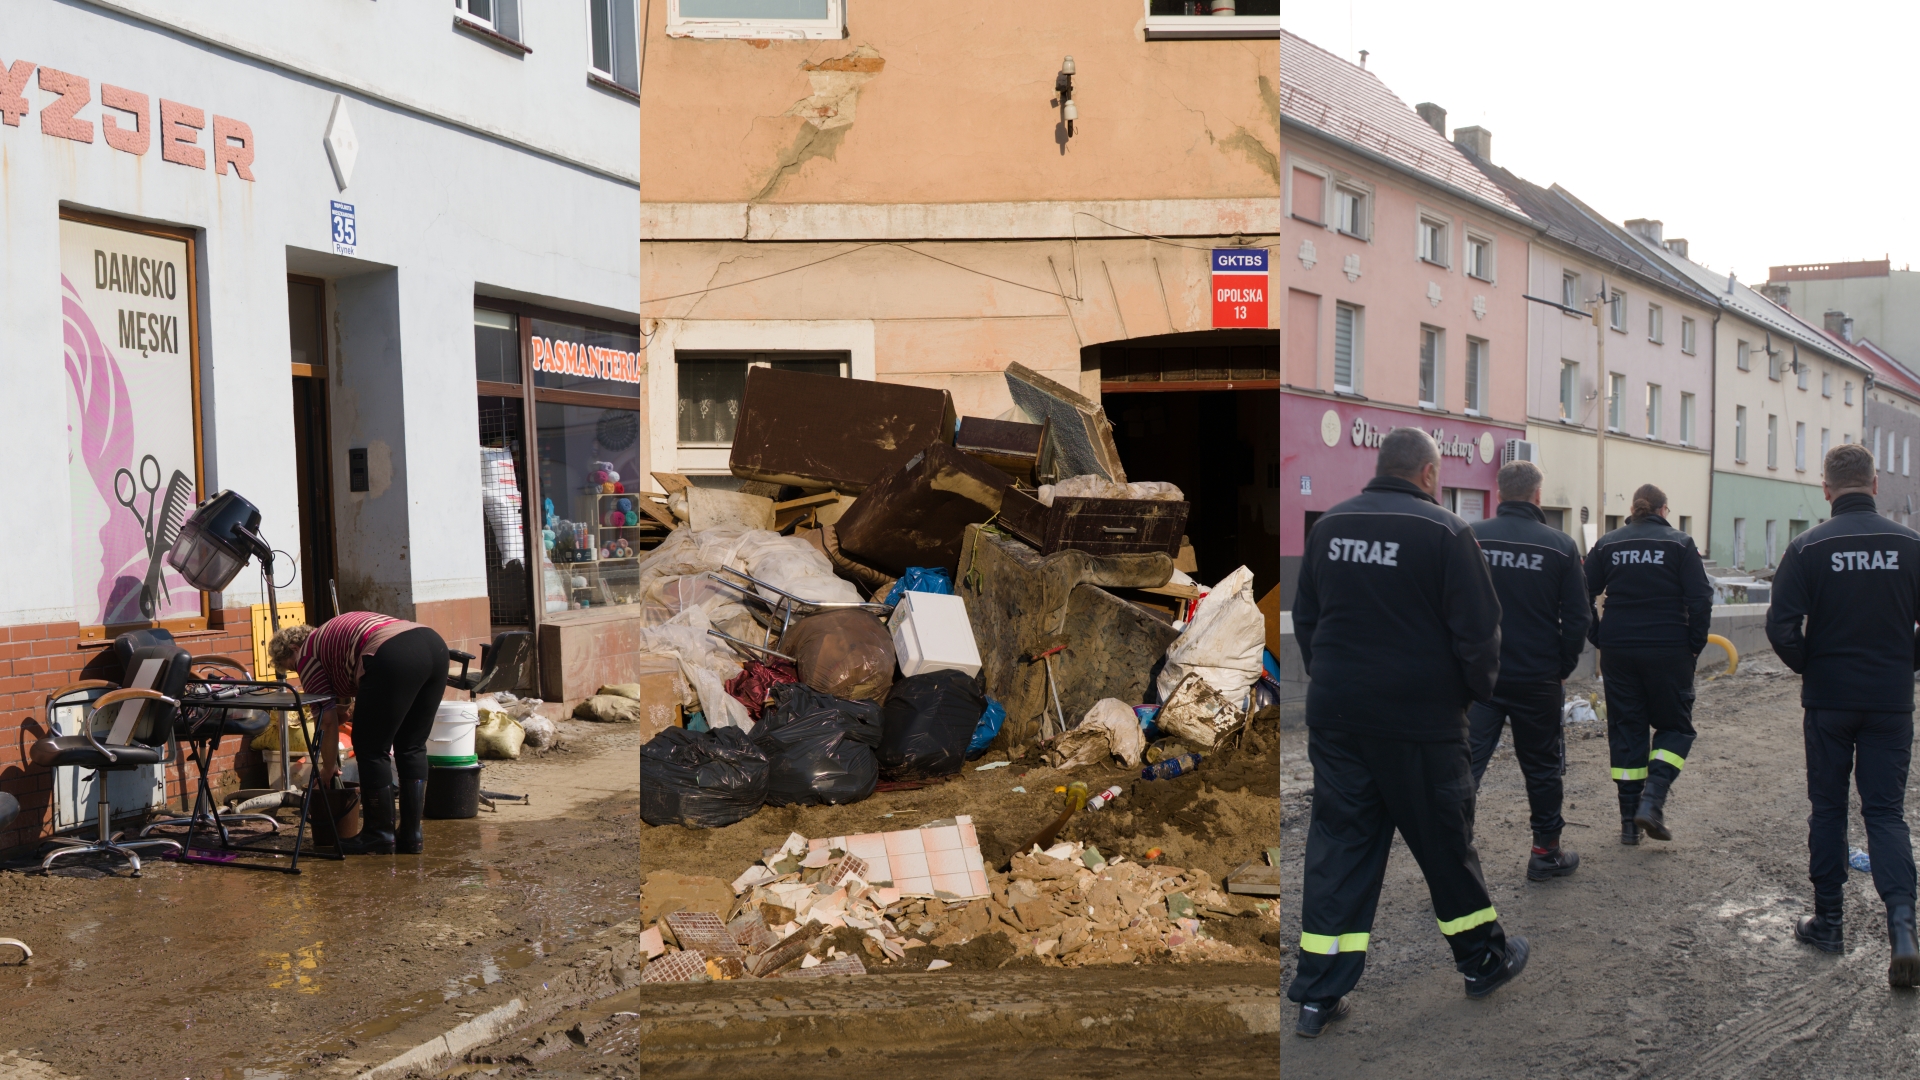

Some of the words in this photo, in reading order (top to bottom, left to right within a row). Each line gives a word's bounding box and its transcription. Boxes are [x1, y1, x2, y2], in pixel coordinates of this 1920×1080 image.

[0, 58, 256, 182] YZJER
[333, 215, 355, 245] 35
[336, 243, 355, 256] Rynek
[1218, 255, 1262, 266] GKTBS
[94, 249, 176, 301] DAMSKO
[1217, 288, 1263, 303] OPOLSKA
[1234, 305, 1247, 320] 13
[118, 308, 178, 359] MĘSKI
